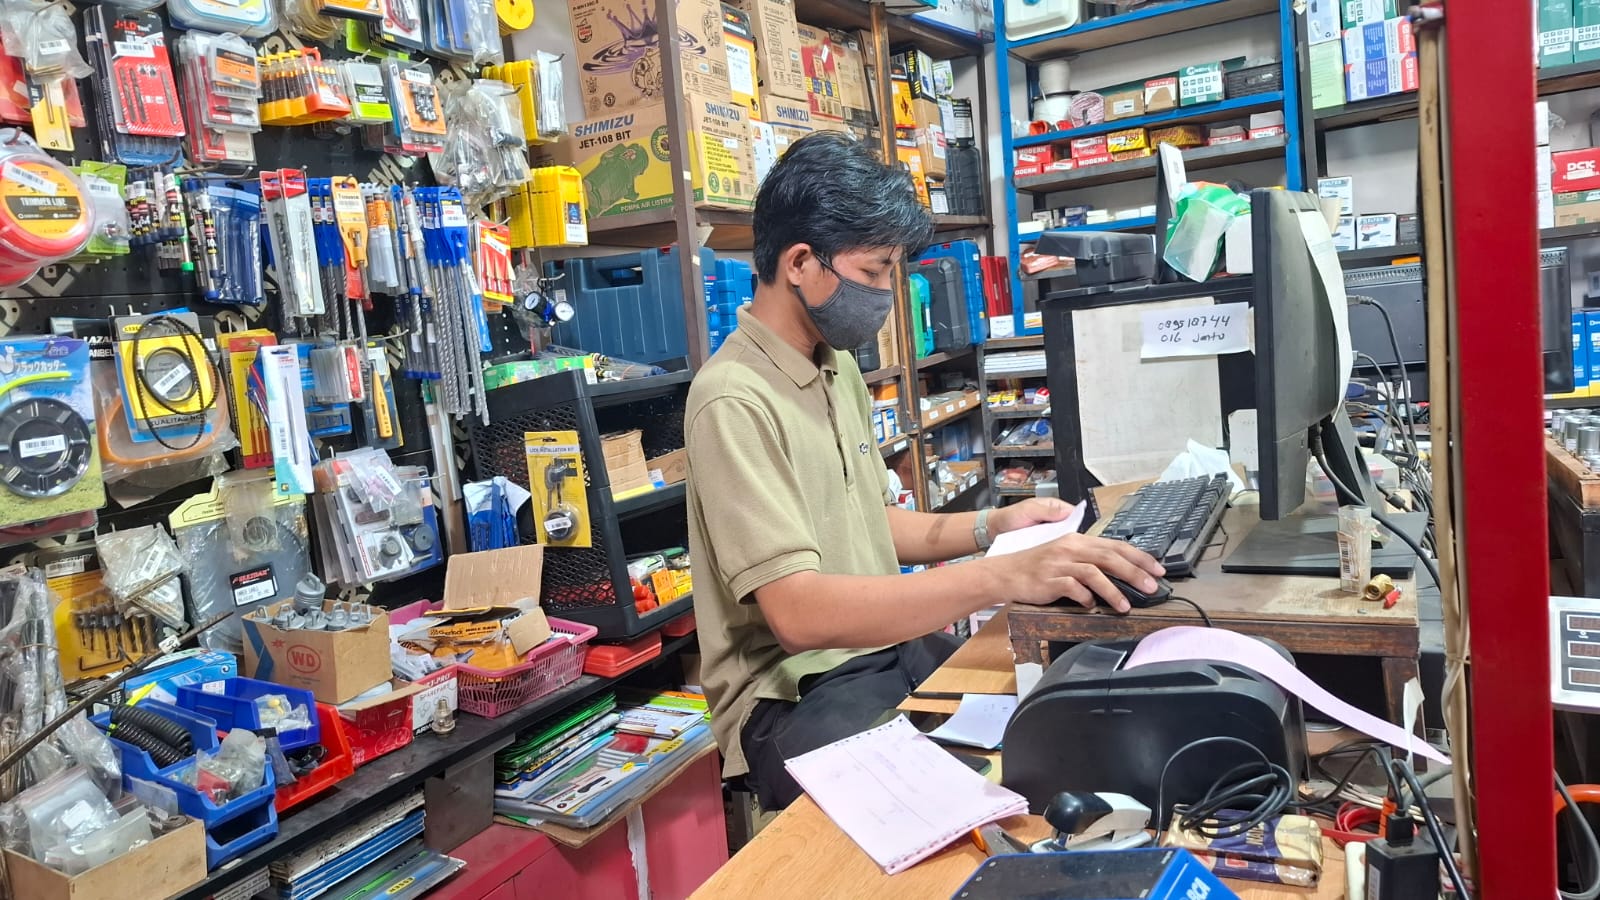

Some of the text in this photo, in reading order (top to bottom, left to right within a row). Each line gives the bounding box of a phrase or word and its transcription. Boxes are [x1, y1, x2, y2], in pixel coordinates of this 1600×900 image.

[705, 102, 740, 121] SHIMIZU
[776, 105, 809, 122] SHIMIZU
[575, 113, 634, 137] SHIMIZU
[579, 130, 632, 150] JET-108 BIT
[1018, 146, 1046, 154] MODERN
[1078, 156, 1108, 167] MODERN
[1567, 160, 1596, 171] DCK
[1014, 167, 1037, 175] ODERN
[620, 204, 640, 213] POMPA
[291, 651, 316, 667] WD
